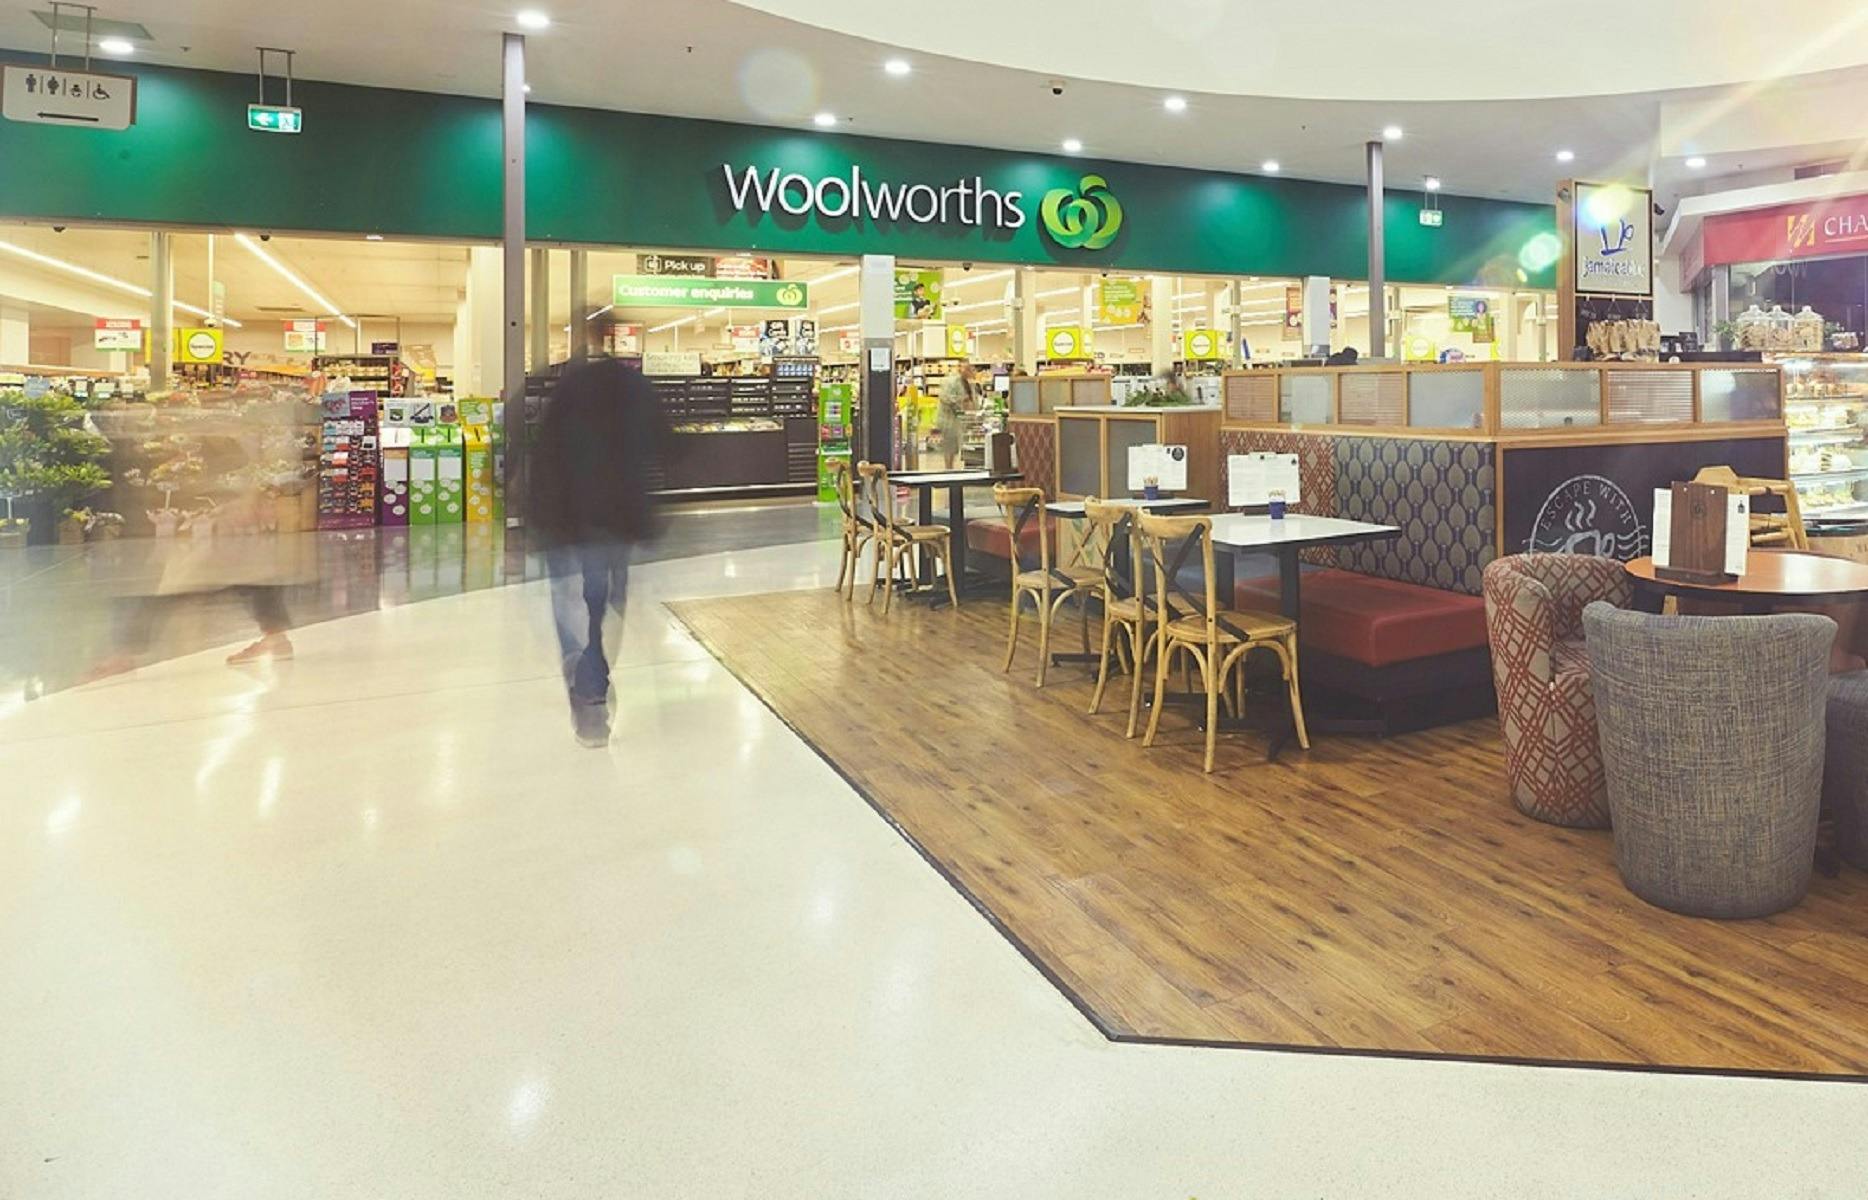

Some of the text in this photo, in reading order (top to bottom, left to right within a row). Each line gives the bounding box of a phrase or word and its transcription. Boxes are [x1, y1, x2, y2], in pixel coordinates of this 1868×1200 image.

[723, 163, 1026, 229] Woolworths
[664, 259, 688, 271] Pick
[690, 262, 706, 273] up
[618, 284, 754, 301] Customer enquiries
[1540, 480, 1633, 531] ESCAPE WITH
